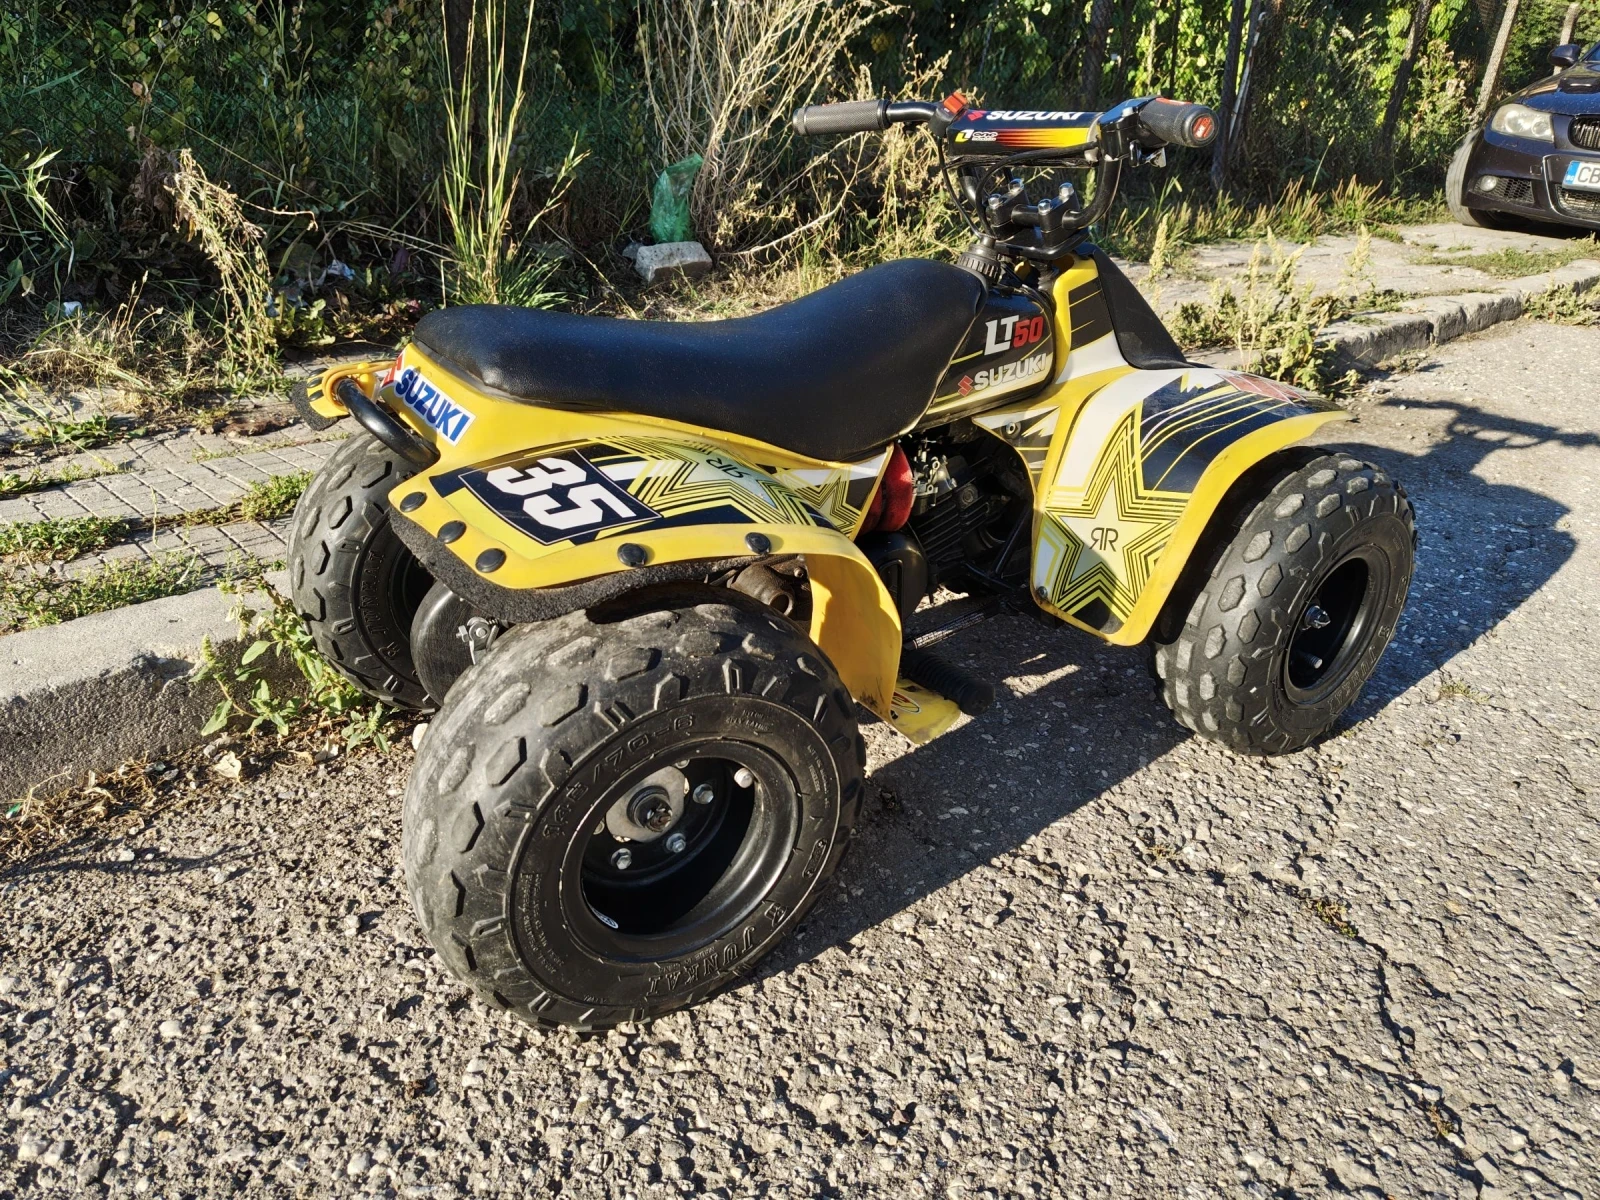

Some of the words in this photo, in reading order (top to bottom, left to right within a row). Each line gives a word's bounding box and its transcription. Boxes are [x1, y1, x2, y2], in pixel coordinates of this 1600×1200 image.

[986, 110, 1085, 121] SUZUKI
[395, 368, 471, 442] SUZUKI
[974, 353, 1047, 391] SUZUKI
[486, 457, 637, 530] 35
[646, 925, 755, 996] JUNKAI
